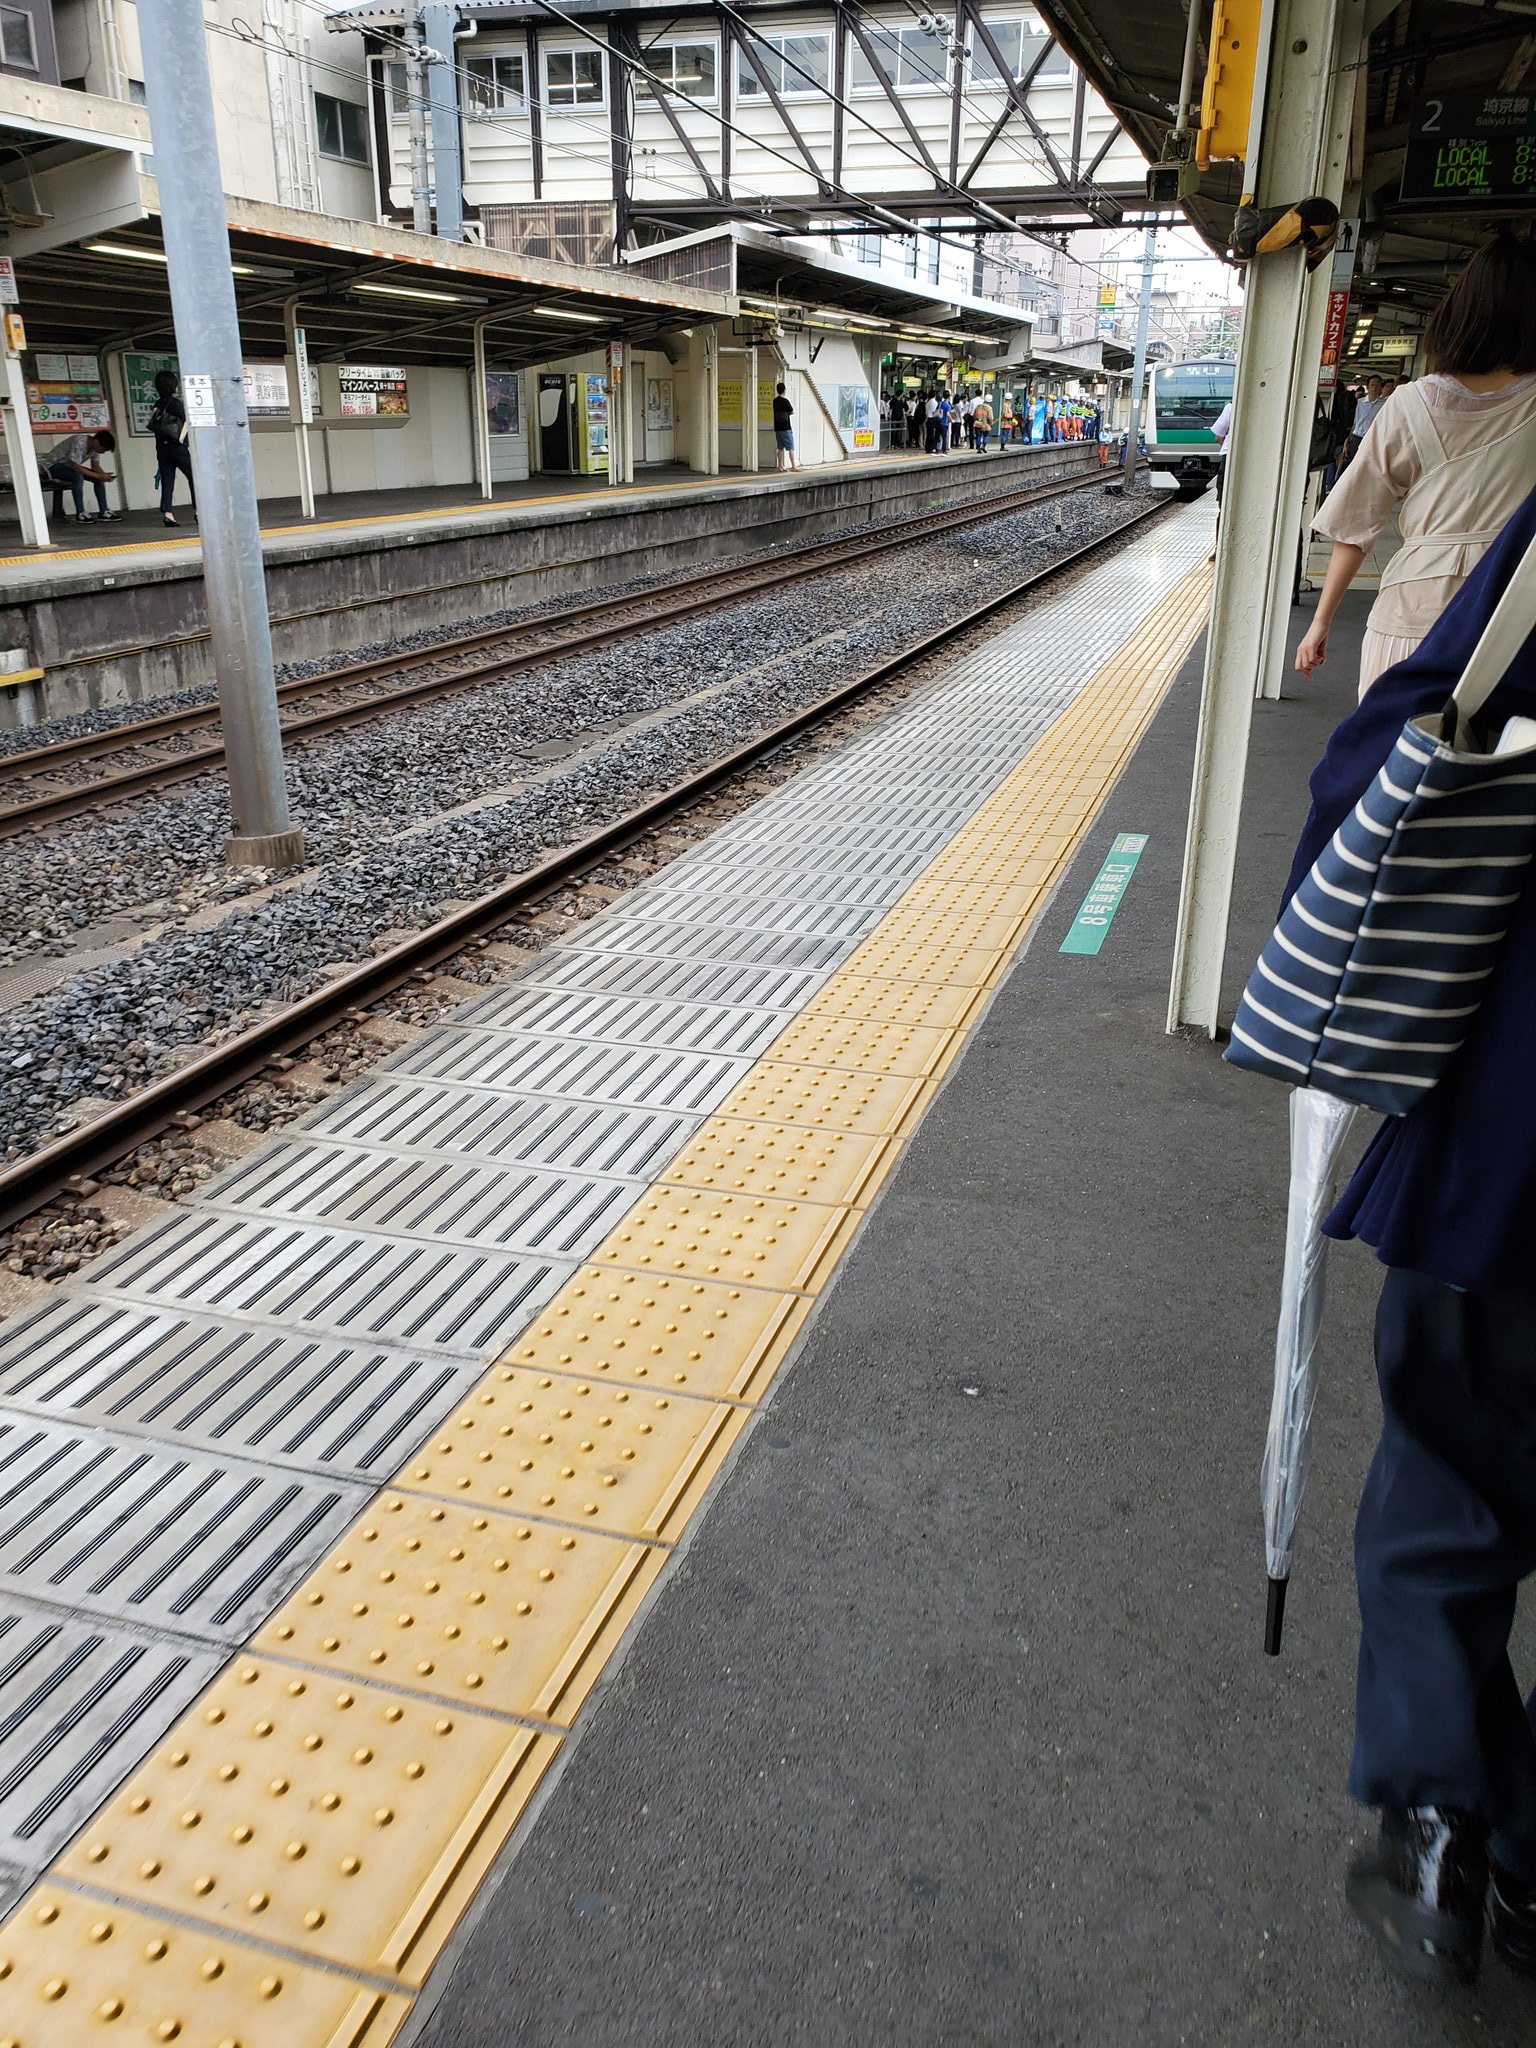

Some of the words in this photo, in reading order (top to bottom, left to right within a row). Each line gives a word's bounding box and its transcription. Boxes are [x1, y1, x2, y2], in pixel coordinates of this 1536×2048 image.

[1421, 99, 1443, 132] 2
[1482, 97, 1530, 114] 埼京線
[1437, 147, 1492, 167] LOCAL
[1434, 167, 1489, 188] LOCAL
[1328, 293, 1344, 349] ネットカフェ
[195, 390, 203, 406] 5
[1079, 863, 1132, 926] 8号車乗車口
